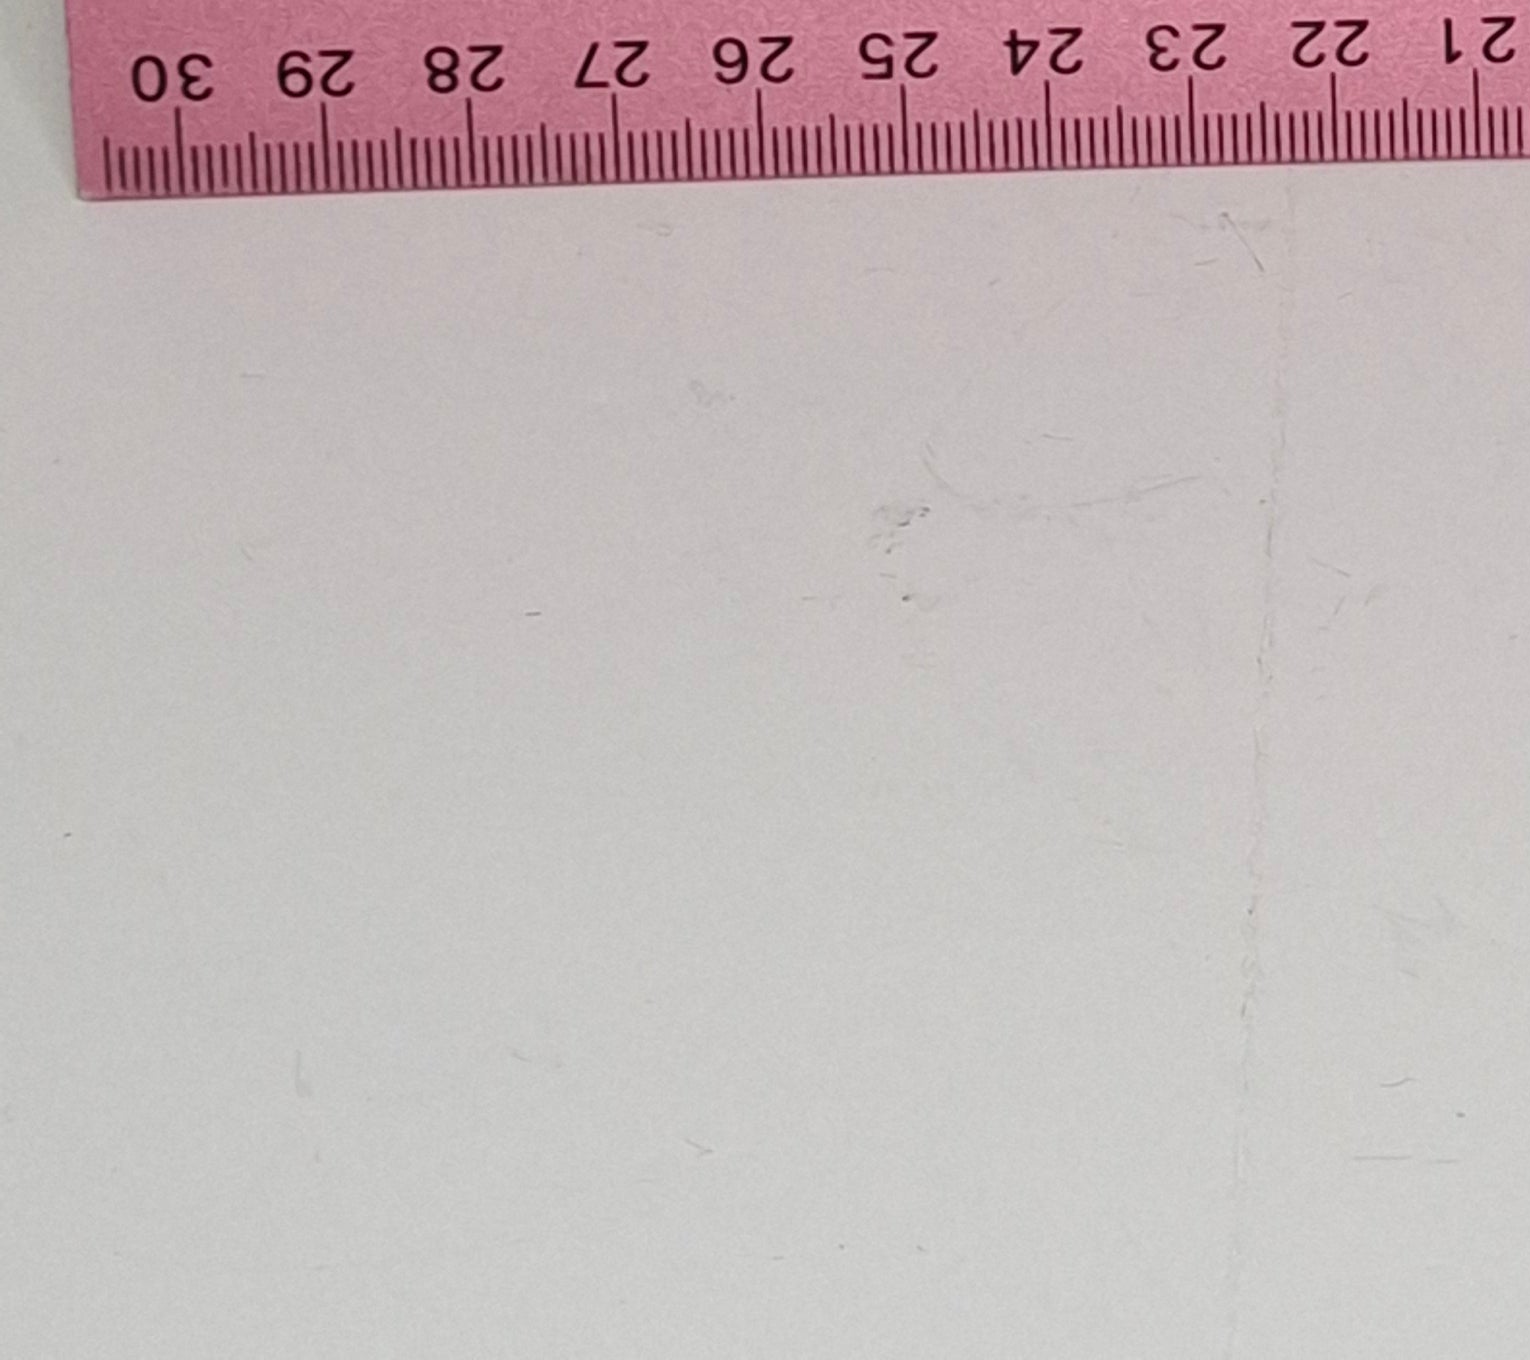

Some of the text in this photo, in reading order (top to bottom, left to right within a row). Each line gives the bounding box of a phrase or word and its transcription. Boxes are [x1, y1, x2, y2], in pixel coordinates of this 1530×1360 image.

[574, 40, 650, 89] 27
[712, 35, 794, 85] 26
[858, 31, 938, 80] 25
[1003, 27, 1083, 76] 24
[1145, 22, 1227, 73] 23
[1290, 19, 1370, 69] 22
[1443, 15, 1516, 65] 21
[132, 53, 213, 102] 30
[277, 49, 355, 99] 29
[424, 44, 505, 94] 28
